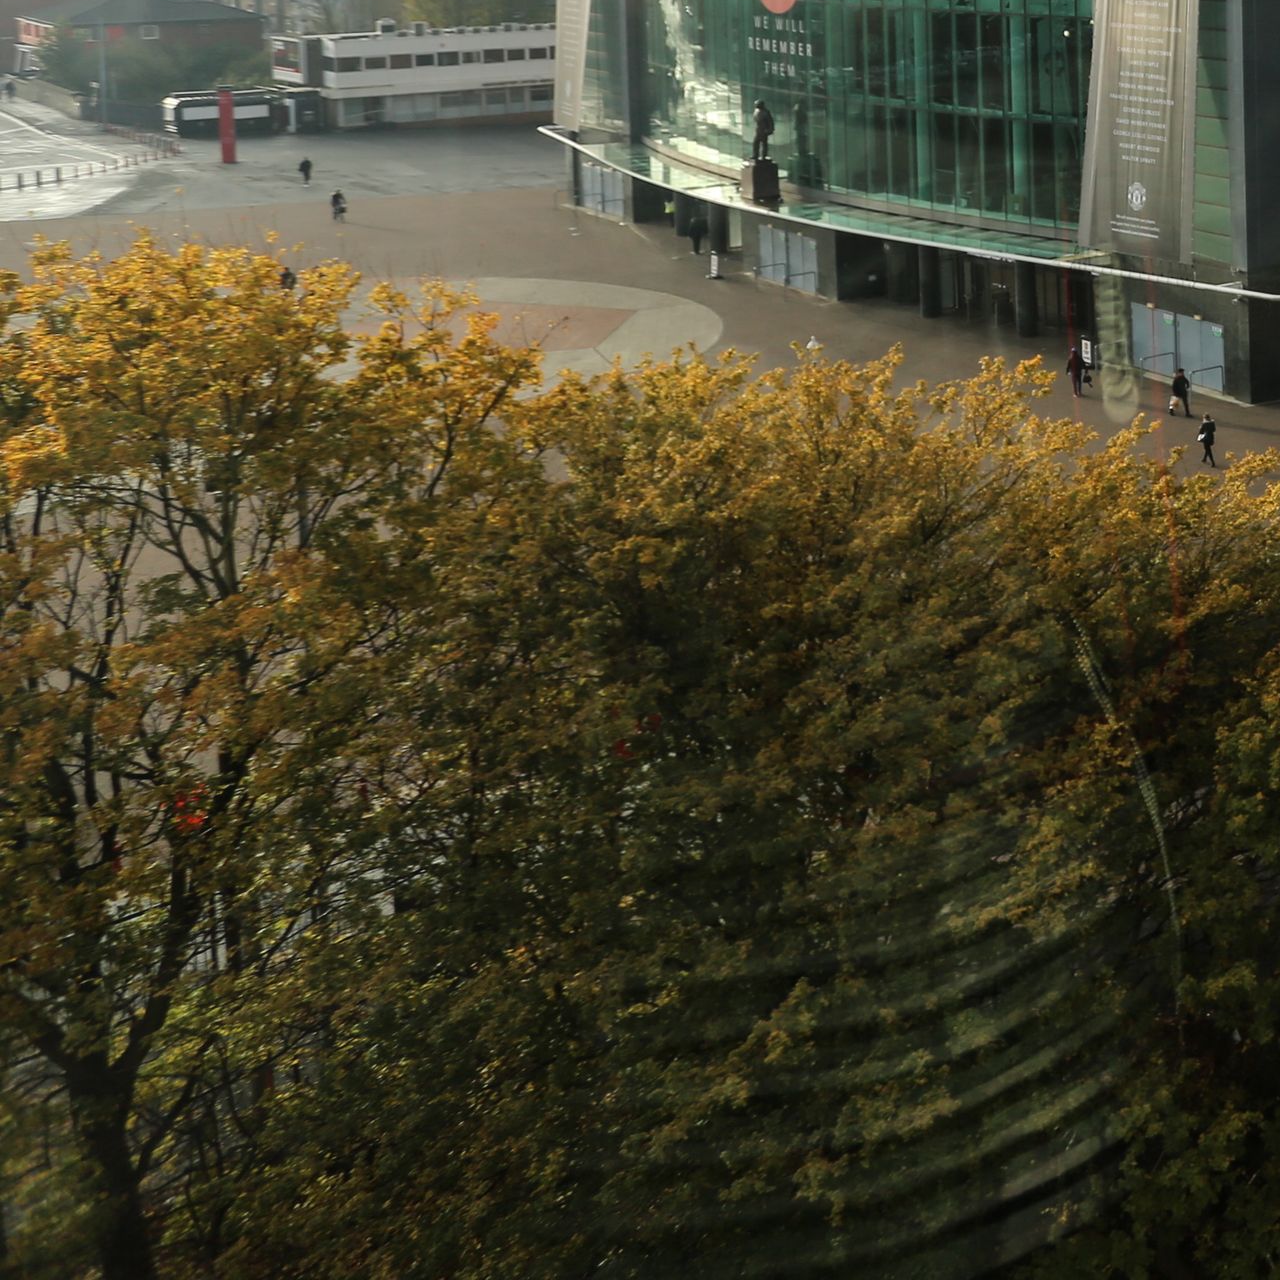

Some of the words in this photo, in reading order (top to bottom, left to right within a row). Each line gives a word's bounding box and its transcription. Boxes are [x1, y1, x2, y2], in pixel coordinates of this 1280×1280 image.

[754, 16, 769, 29] WE
[775, 17, 805, 33] WILL
[748, 36, 812, 57] REMEMBER
[764, 61, 796, 77] THEM
